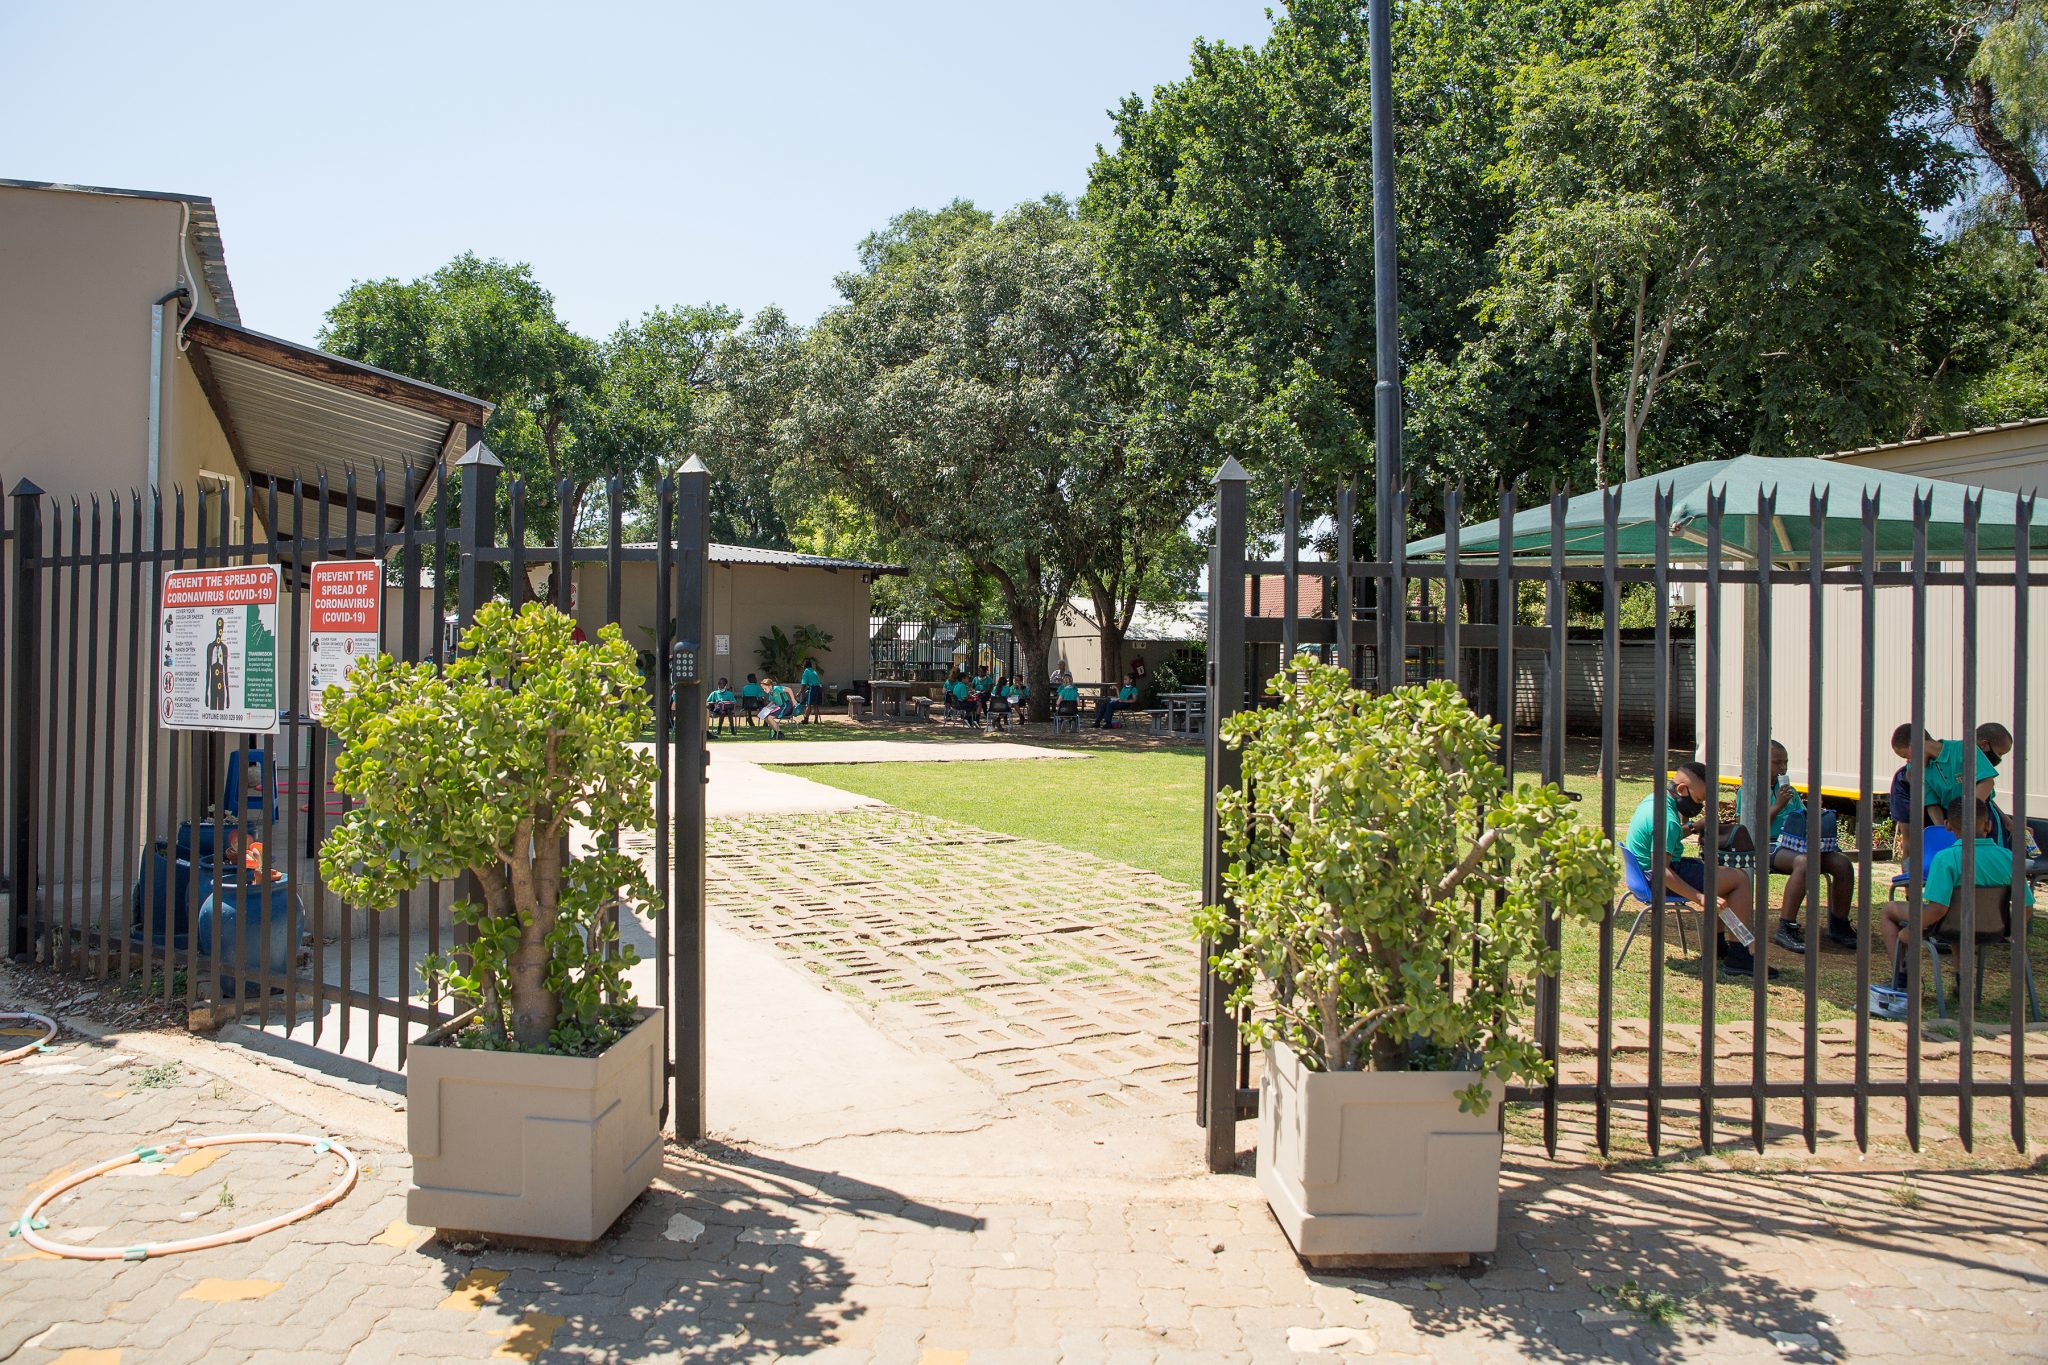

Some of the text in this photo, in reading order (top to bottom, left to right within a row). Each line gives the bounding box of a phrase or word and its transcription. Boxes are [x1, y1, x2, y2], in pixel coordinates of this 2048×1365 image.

[168, 573, 273, 589] PREVENT THE SPREAD OF
[317, 570, 374, 582] PREVENT THE
[168, 588, 272, 604] CORONAVIRUS (COVID-19)
[322, 584, 368, 596] SPREAD OF
[315, 598, 375, 609] CORONAVIRUS
[322, 612, 366, 625] (COVID-19)
